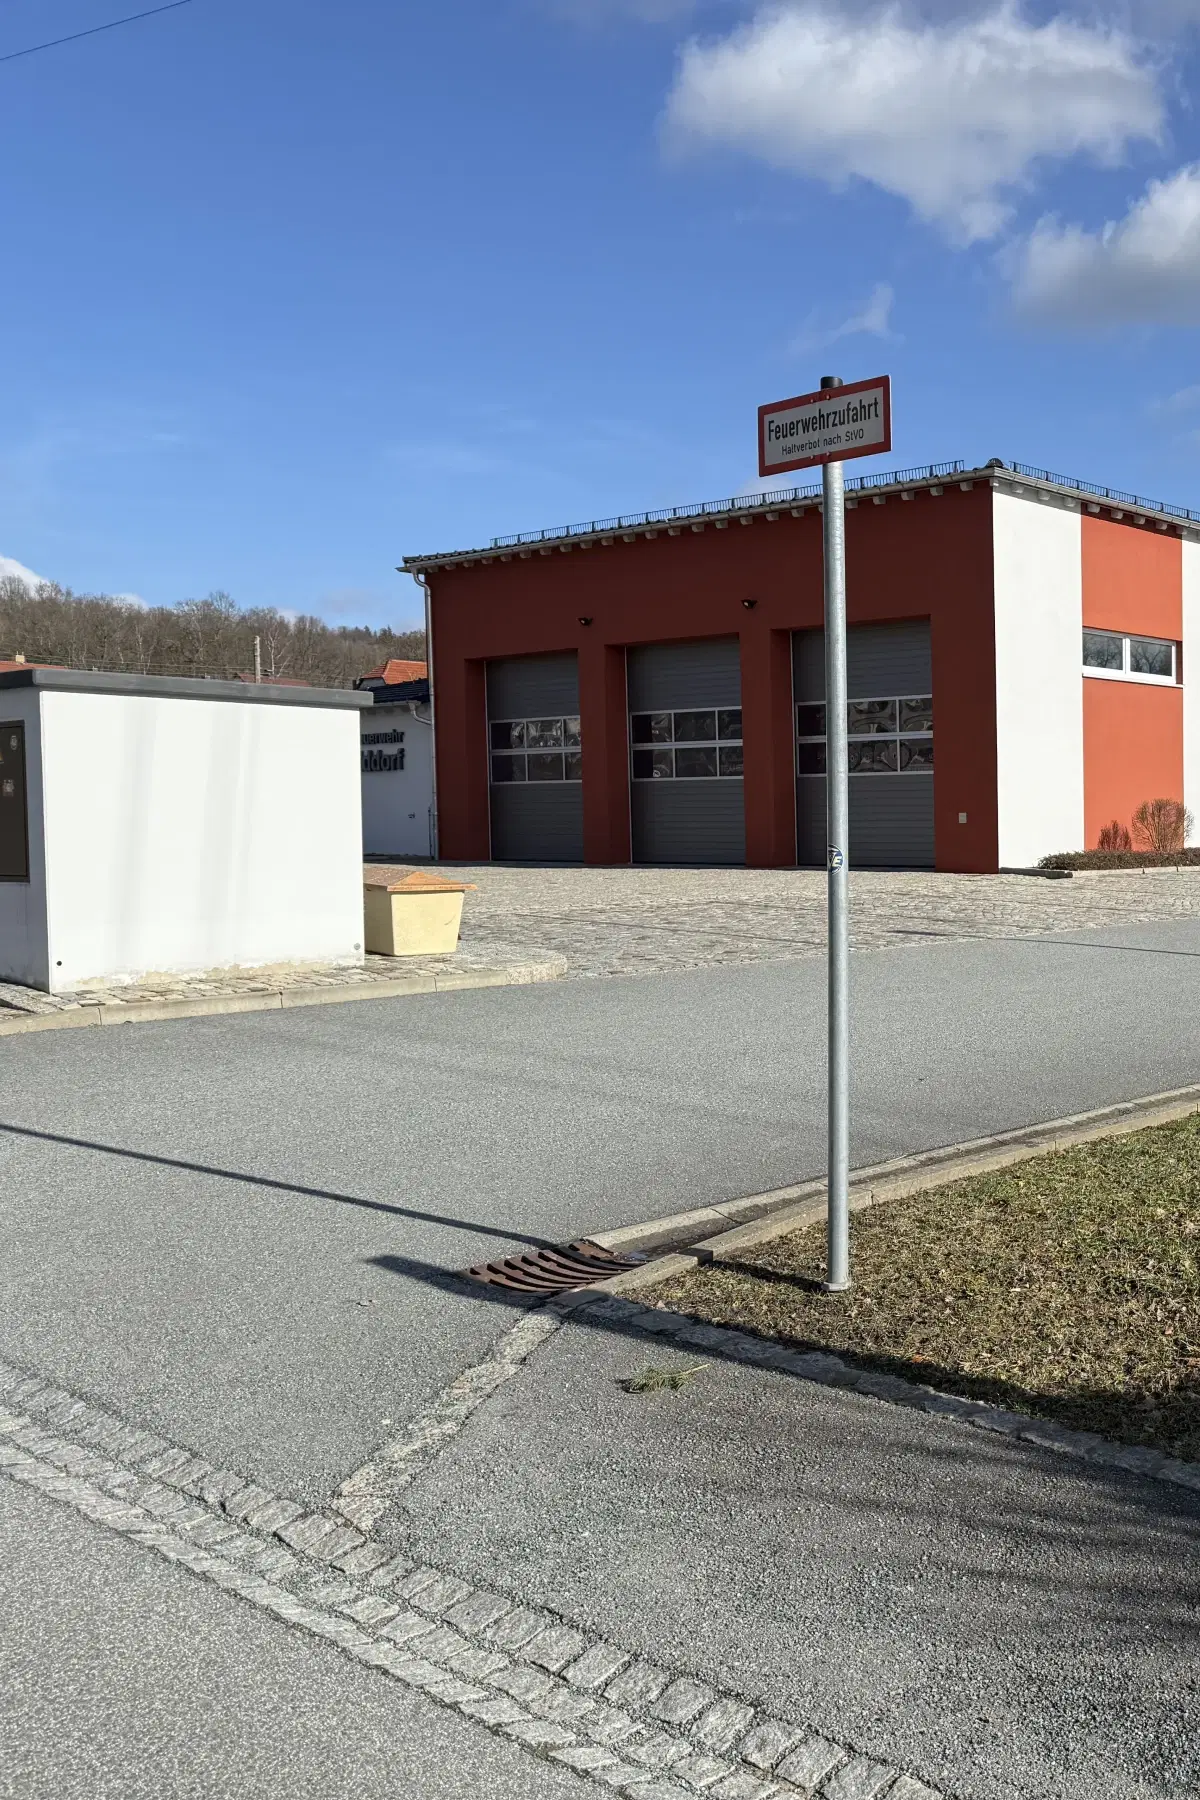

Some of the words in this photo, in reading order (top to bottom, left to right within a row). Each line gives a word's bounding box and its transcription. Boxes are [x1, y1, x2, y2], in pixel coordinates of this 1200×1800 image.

[768, 397, 879, 442] Feuerwehrzufahrt
[781, 438, 821, 456] Haltverbot
[823, 434, 842, 446] nach
[845, 428, 864, 442] StVO
[361, 729, 405, 745] uerwehr
